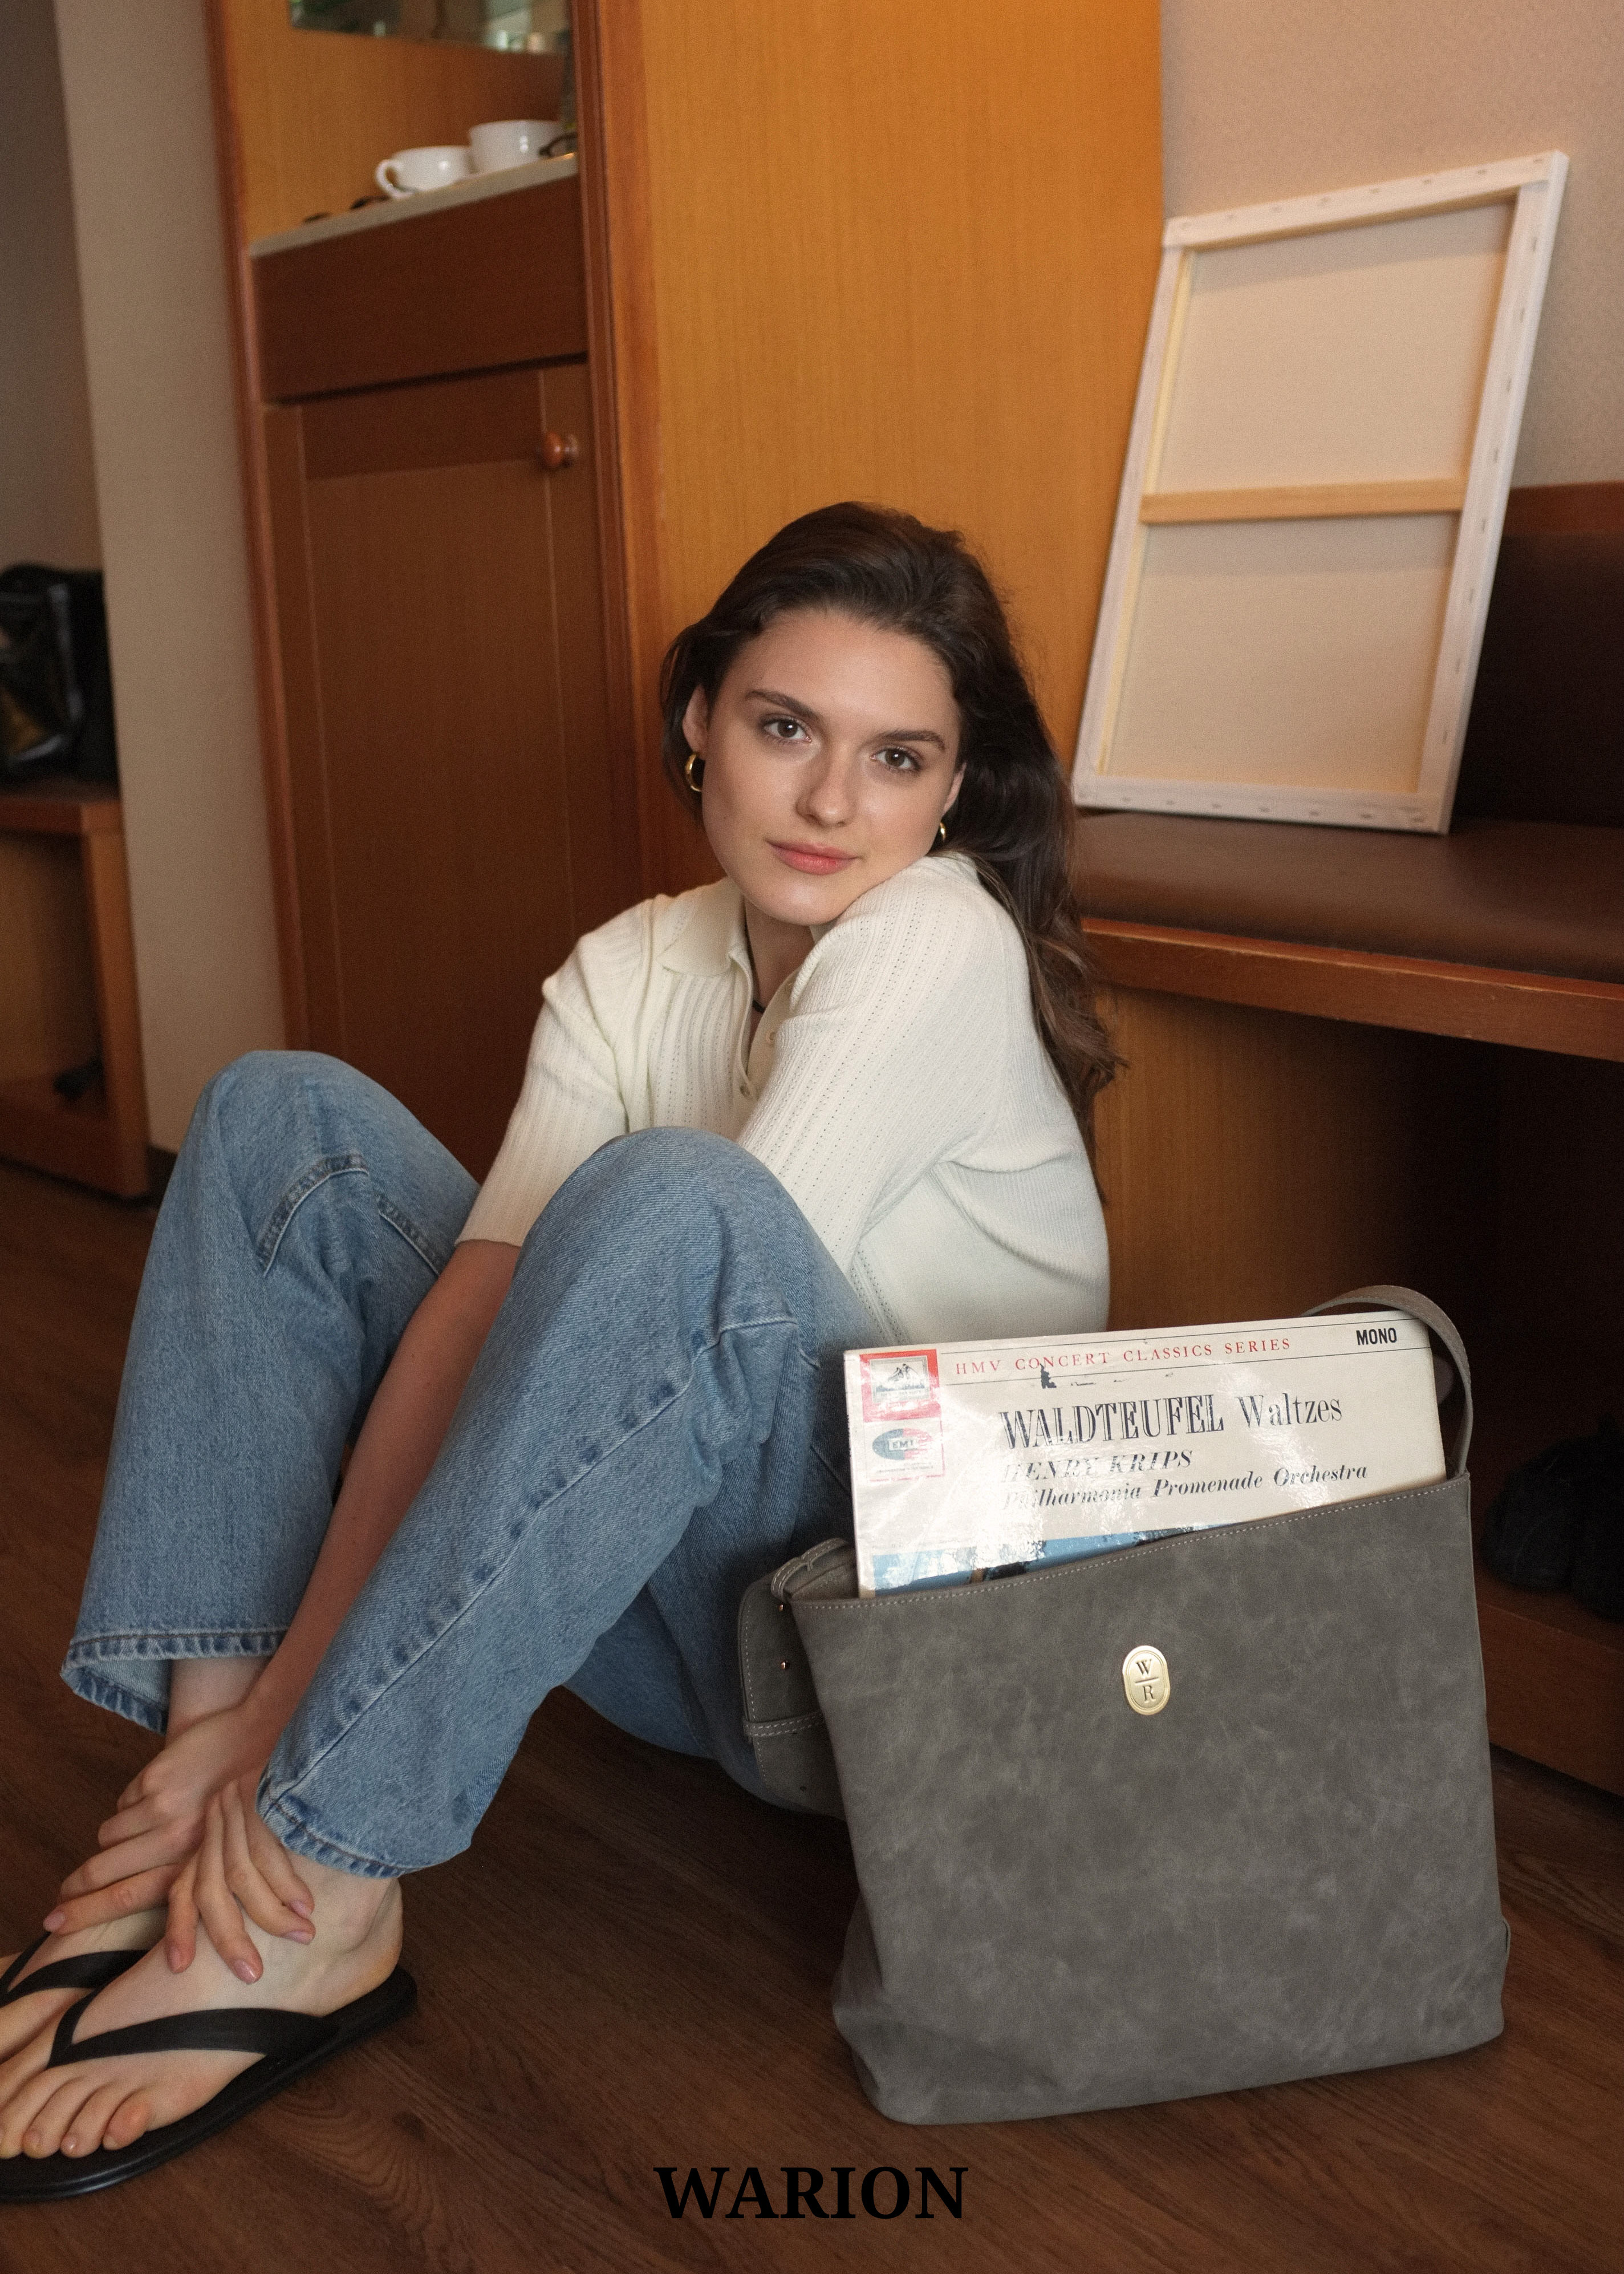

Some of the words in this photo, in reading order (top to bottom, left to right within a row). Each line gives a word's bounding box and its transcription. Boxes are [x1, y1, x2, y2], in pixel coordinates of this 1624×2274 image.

[1355, 1327, 1398, 1346] MONO
[956, 1360, 1001, 1375] HMV
[1014, 1352, 1110, 1371] CONCERT
[1123, 1344, 1213, 1363] CLASSICS
[1224, 1338, 1291, 1355] SERIES
[998, 1394, 1224, 1449] WALDTEUFEL
[1235, 1392, 1342, 1428] Waltzes
[892, 1440, 914, 1449] EMI
[1109, 1449, 1193, 1474] KRIPS
[1150, 1470, 1263, 1498] Promenade
[1273, 1464, 1368, 1487] Orchestra
[1136, 1659, 1152, 1676] W
[1142, 1685, 1156, 1703] R
